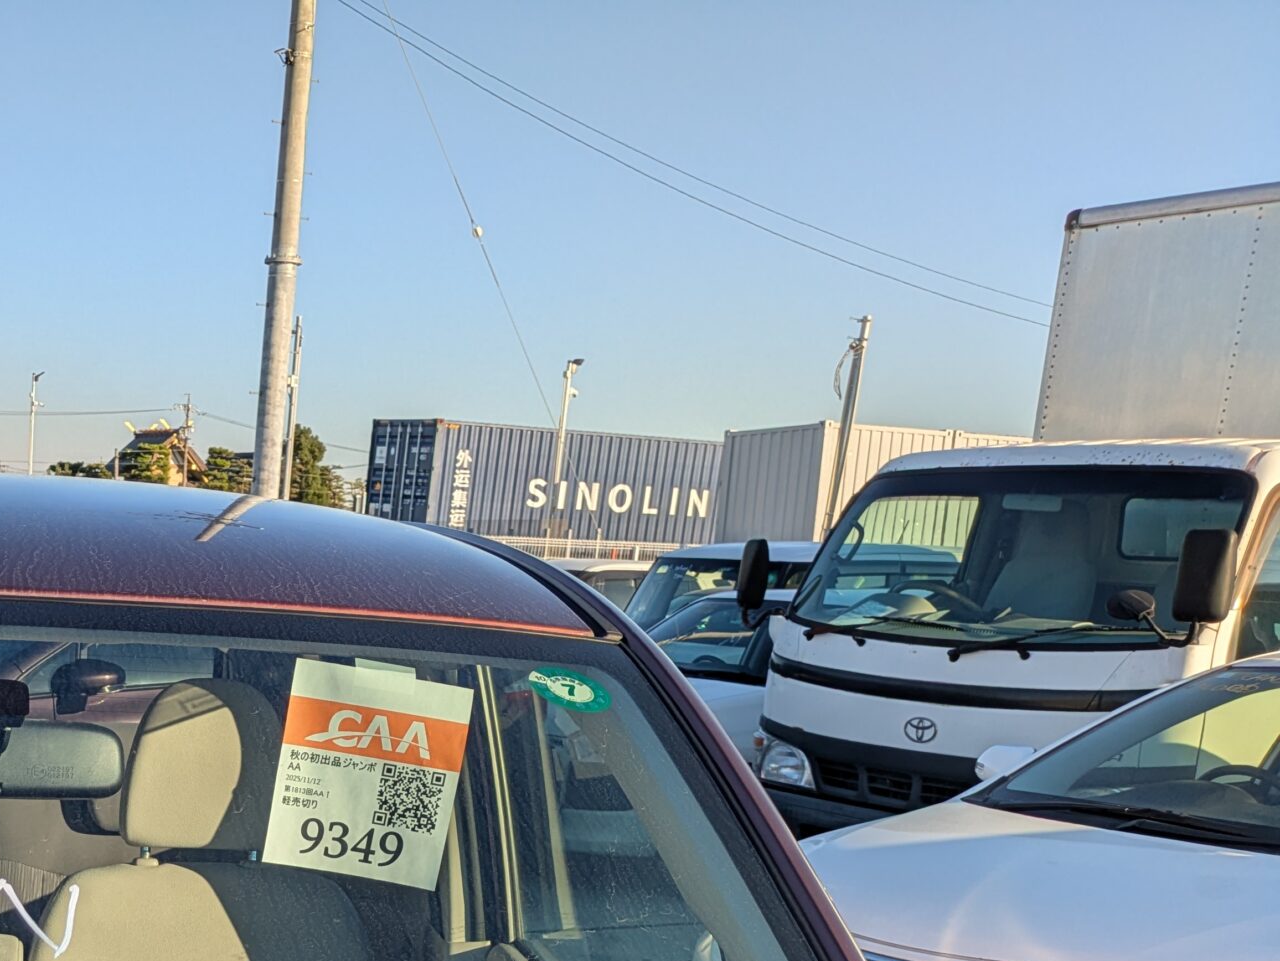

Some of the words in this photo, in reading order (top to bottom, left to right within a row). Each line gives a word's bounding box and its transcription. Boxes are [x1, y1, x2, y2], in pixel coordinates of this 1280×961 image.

[448, 449, 472, 528] 外运集运
[526, 478, 709, 518] SINOLIN
[560, 683, 576, 697] 7
[305, 709, 432, 760] CAA
[287, 761, 301, 772] AA
[290, 749, 377, 773] 秋の初出品ジャンボ
[285, 773, 322, 786] 2025/11/12
[282, 795, 318, 810] 軽売切り
[299, 817, 404, 867] 9349
